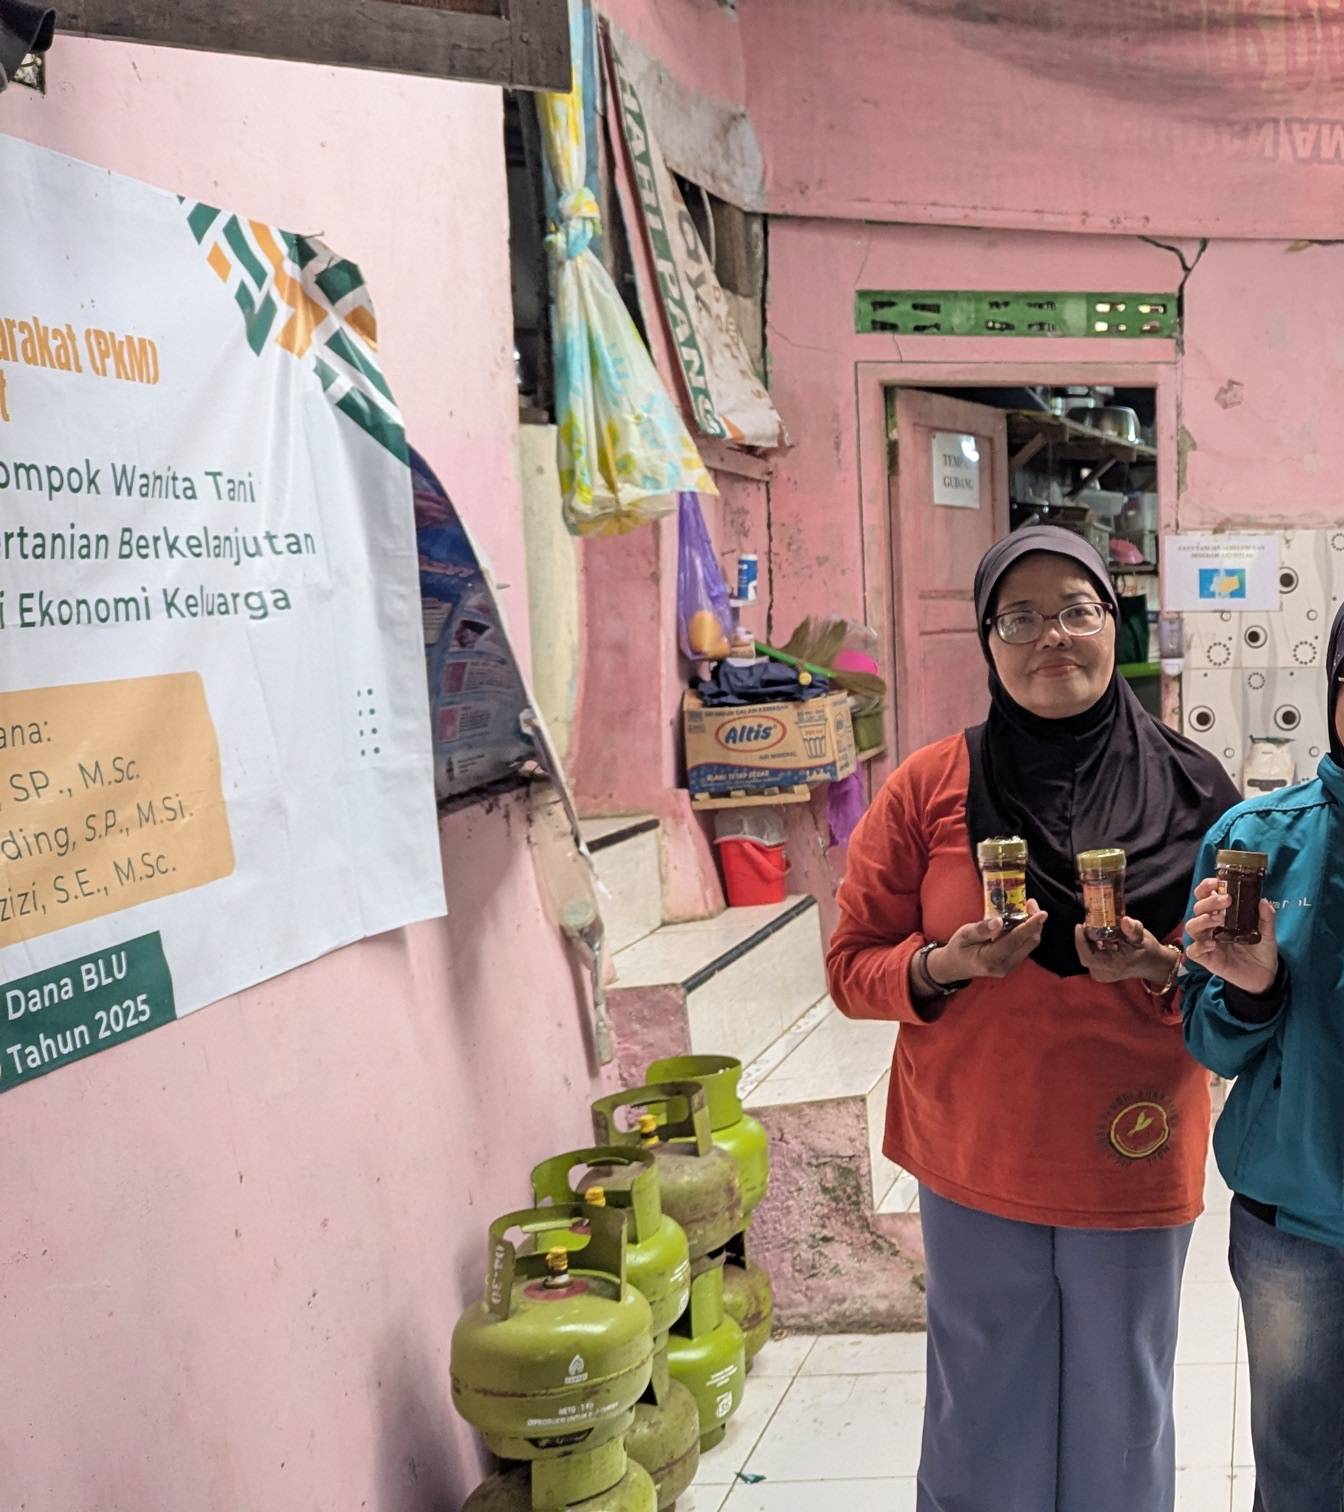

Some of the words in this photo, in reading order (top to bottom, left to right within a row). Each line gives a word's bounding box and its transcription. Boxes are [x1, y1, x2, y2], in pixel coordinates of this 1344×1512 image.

[111, 462, 197, 501] Wanita
[205, 470, 256, 504] Tani
[0, 522, 109, 560] rtanian
[118, 526, 317, 567] Berkelanjutan
[18, 587, 151, 628] Ekonomi
[164, 587, 293, 622] Keluarga
[724, 722, 774, 746] Altis
[112, 850, 177, 888] M.Sc.
[5, 977, 75, 1021] Dana
[80, 950, 128, 993] BLU
[6, 1025, 91, 1074] Tahun
[94, 993, 151, 1040] 2025
